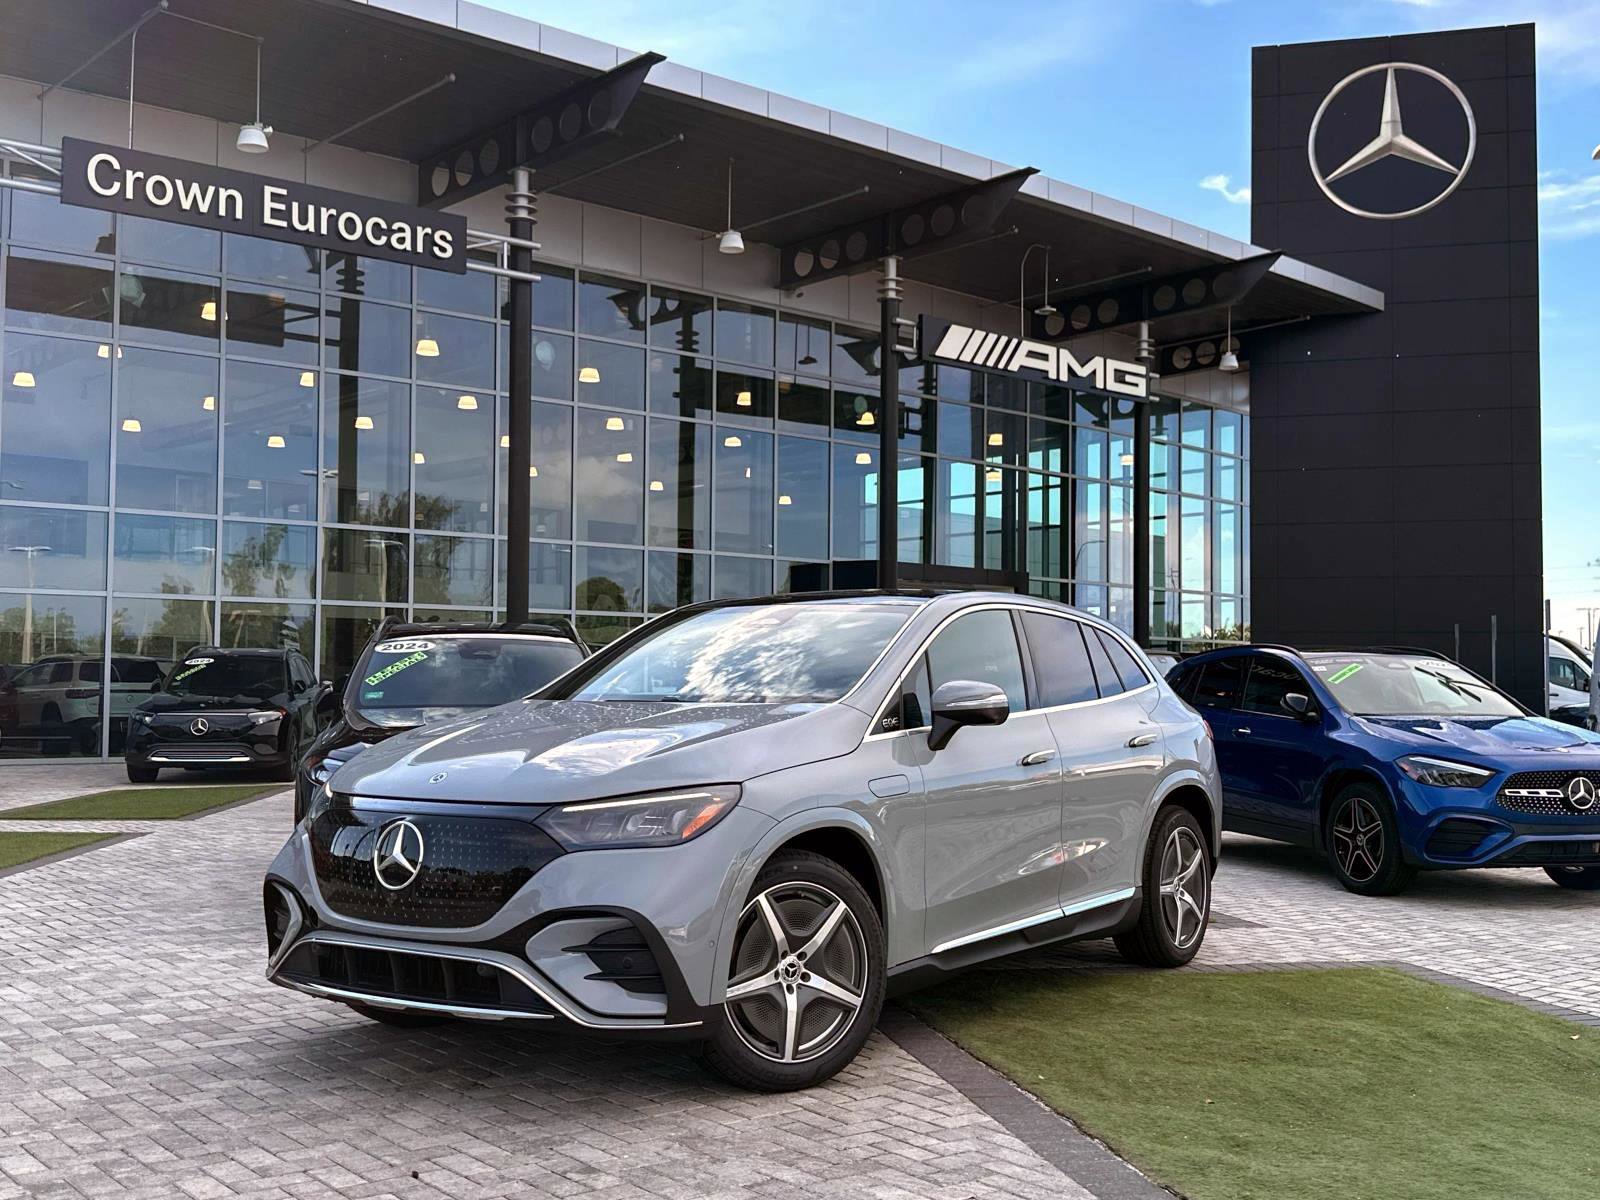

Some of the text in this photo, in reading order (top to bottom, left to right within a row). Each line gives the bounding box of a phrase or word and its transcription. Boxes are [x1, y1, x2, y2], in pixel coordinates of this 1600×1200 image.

[86, 152, 454, 259] Crown Eurocars
[1007, 340, 1147, 397] AMG
[381, 642, 430, 651] 2024
